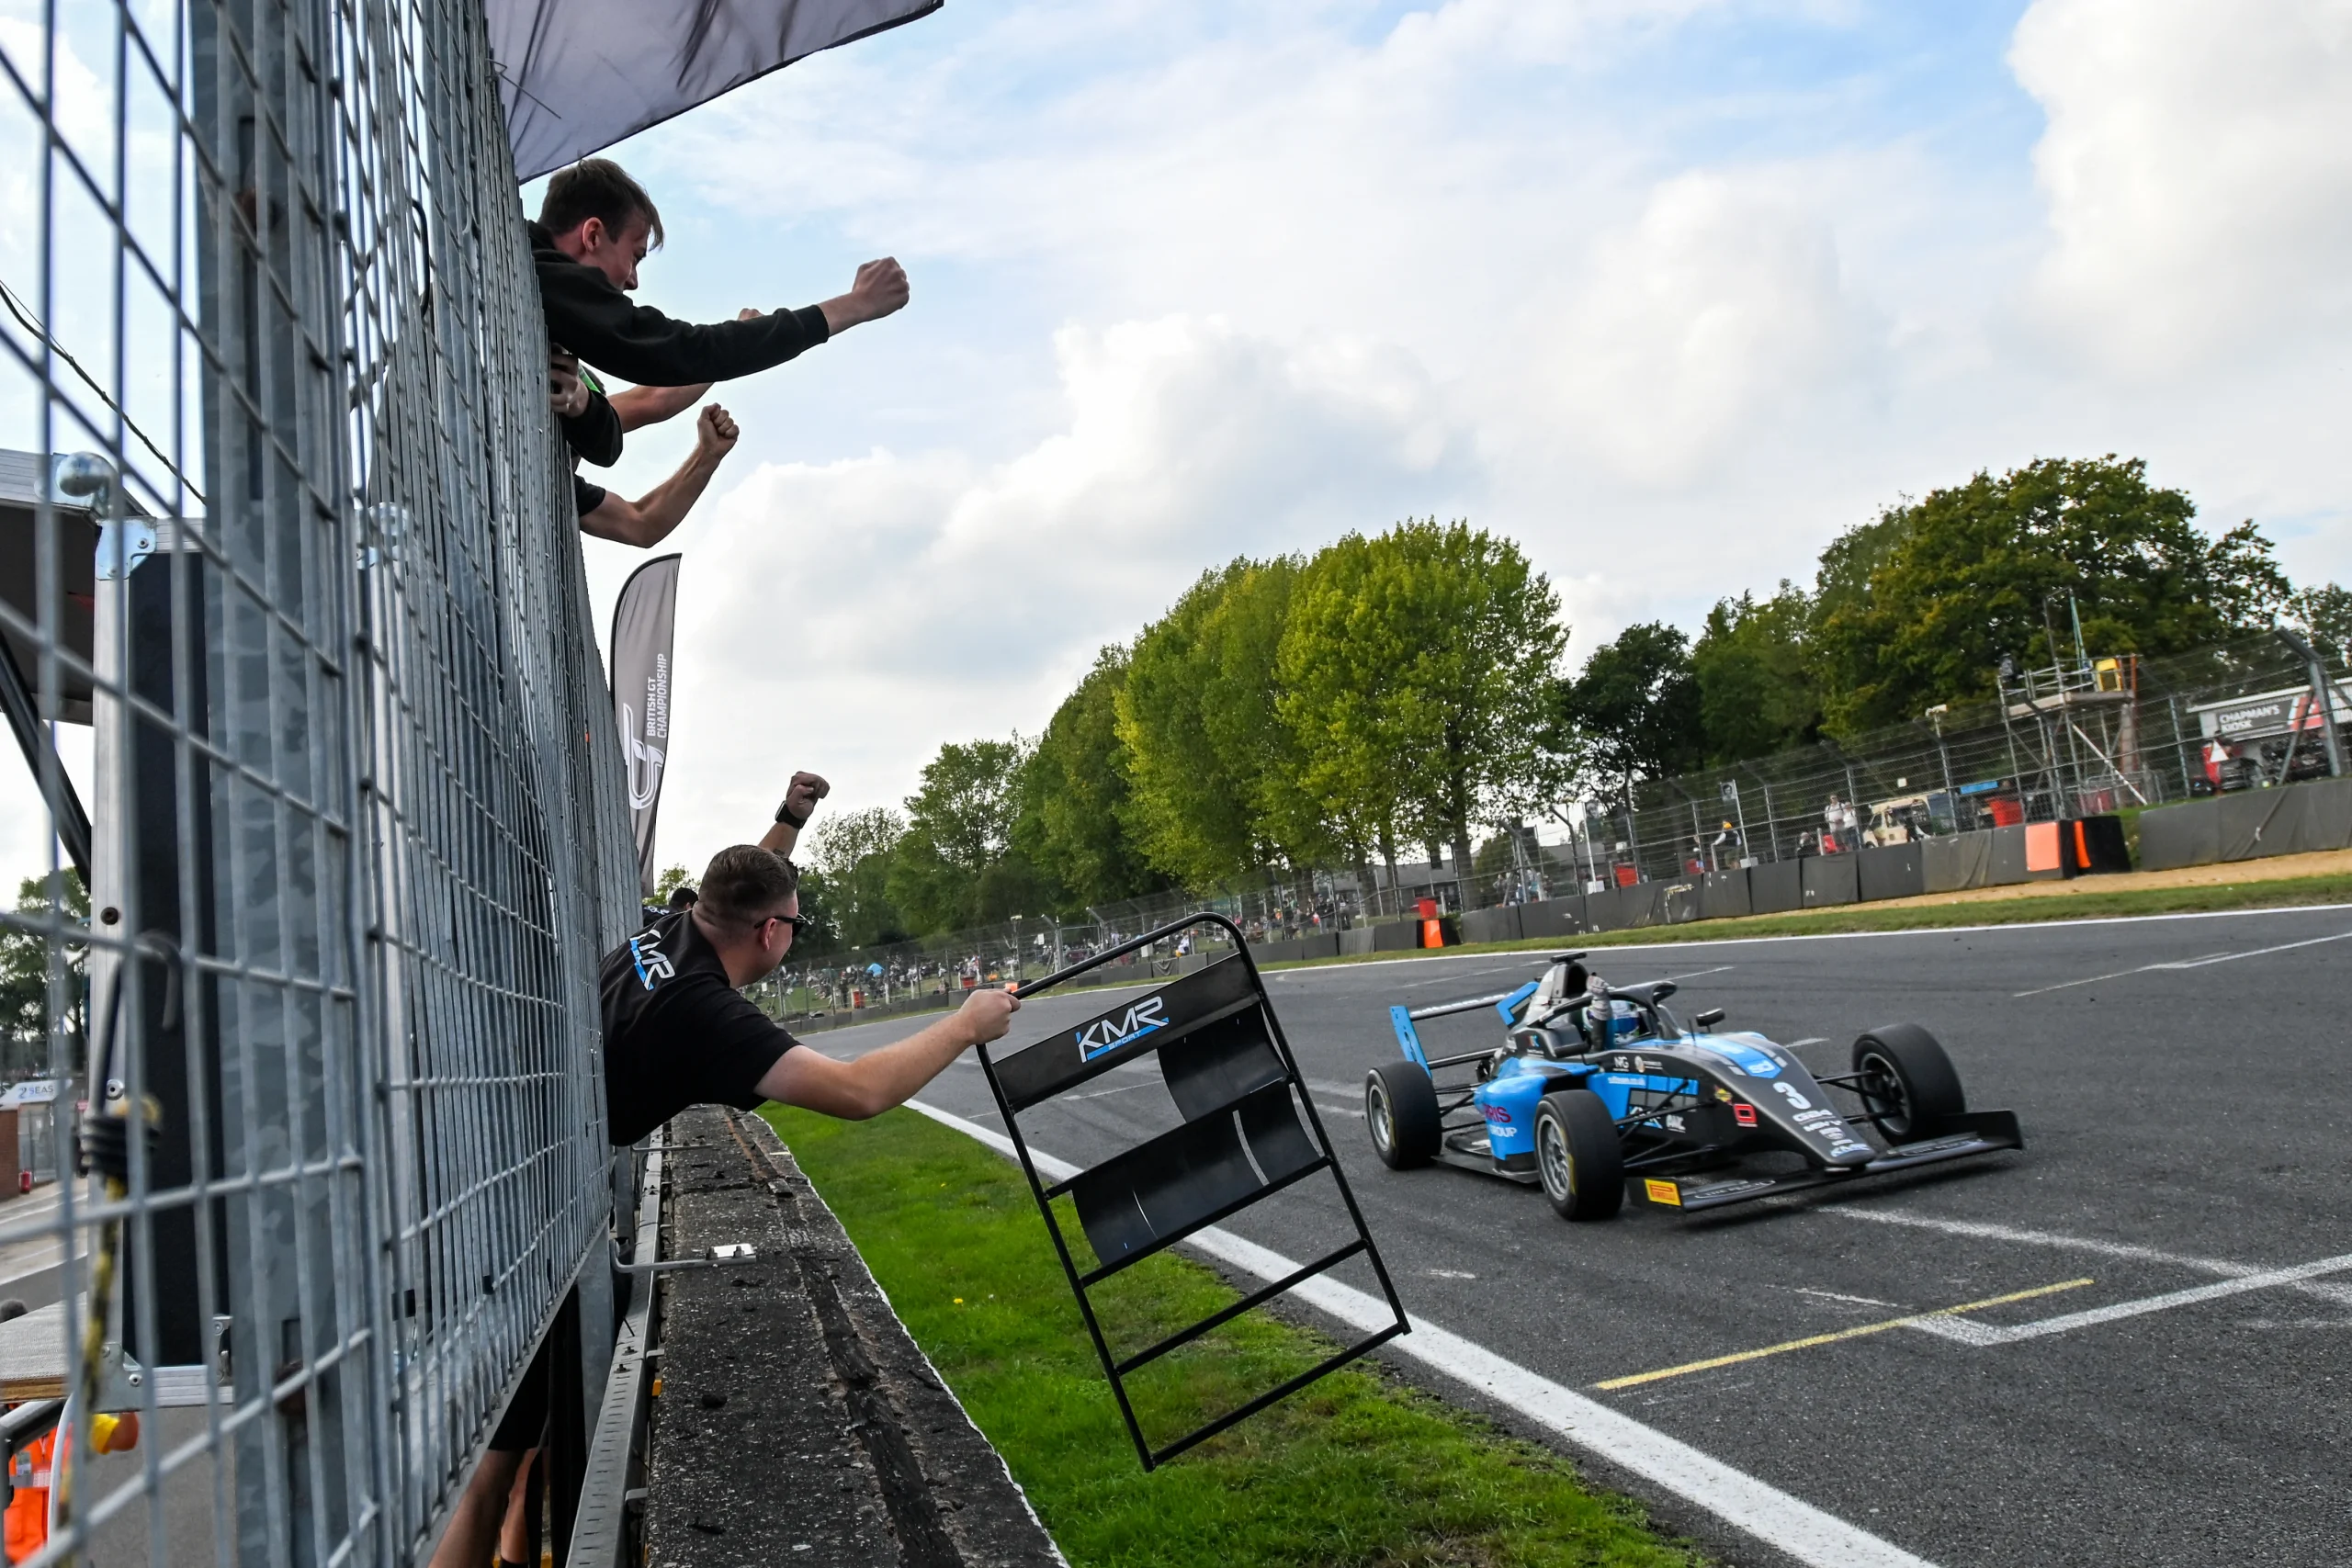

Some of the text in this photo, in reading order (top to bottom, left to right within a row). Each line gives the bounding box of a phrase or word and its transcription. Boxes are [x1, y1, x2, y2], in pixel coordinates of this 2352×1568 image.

[647, 676, 656, 737] BRITISH GT
[657, 653, 667, 739] CHAMPIONSHIP
[1077, 996, 1170, 1063] KMR
[1108, 1031, 1142, 1051] SPORT
[18, 1085, 54, 1100] 2 SEAS
[1772, 1081, 1813, 1110] 3
